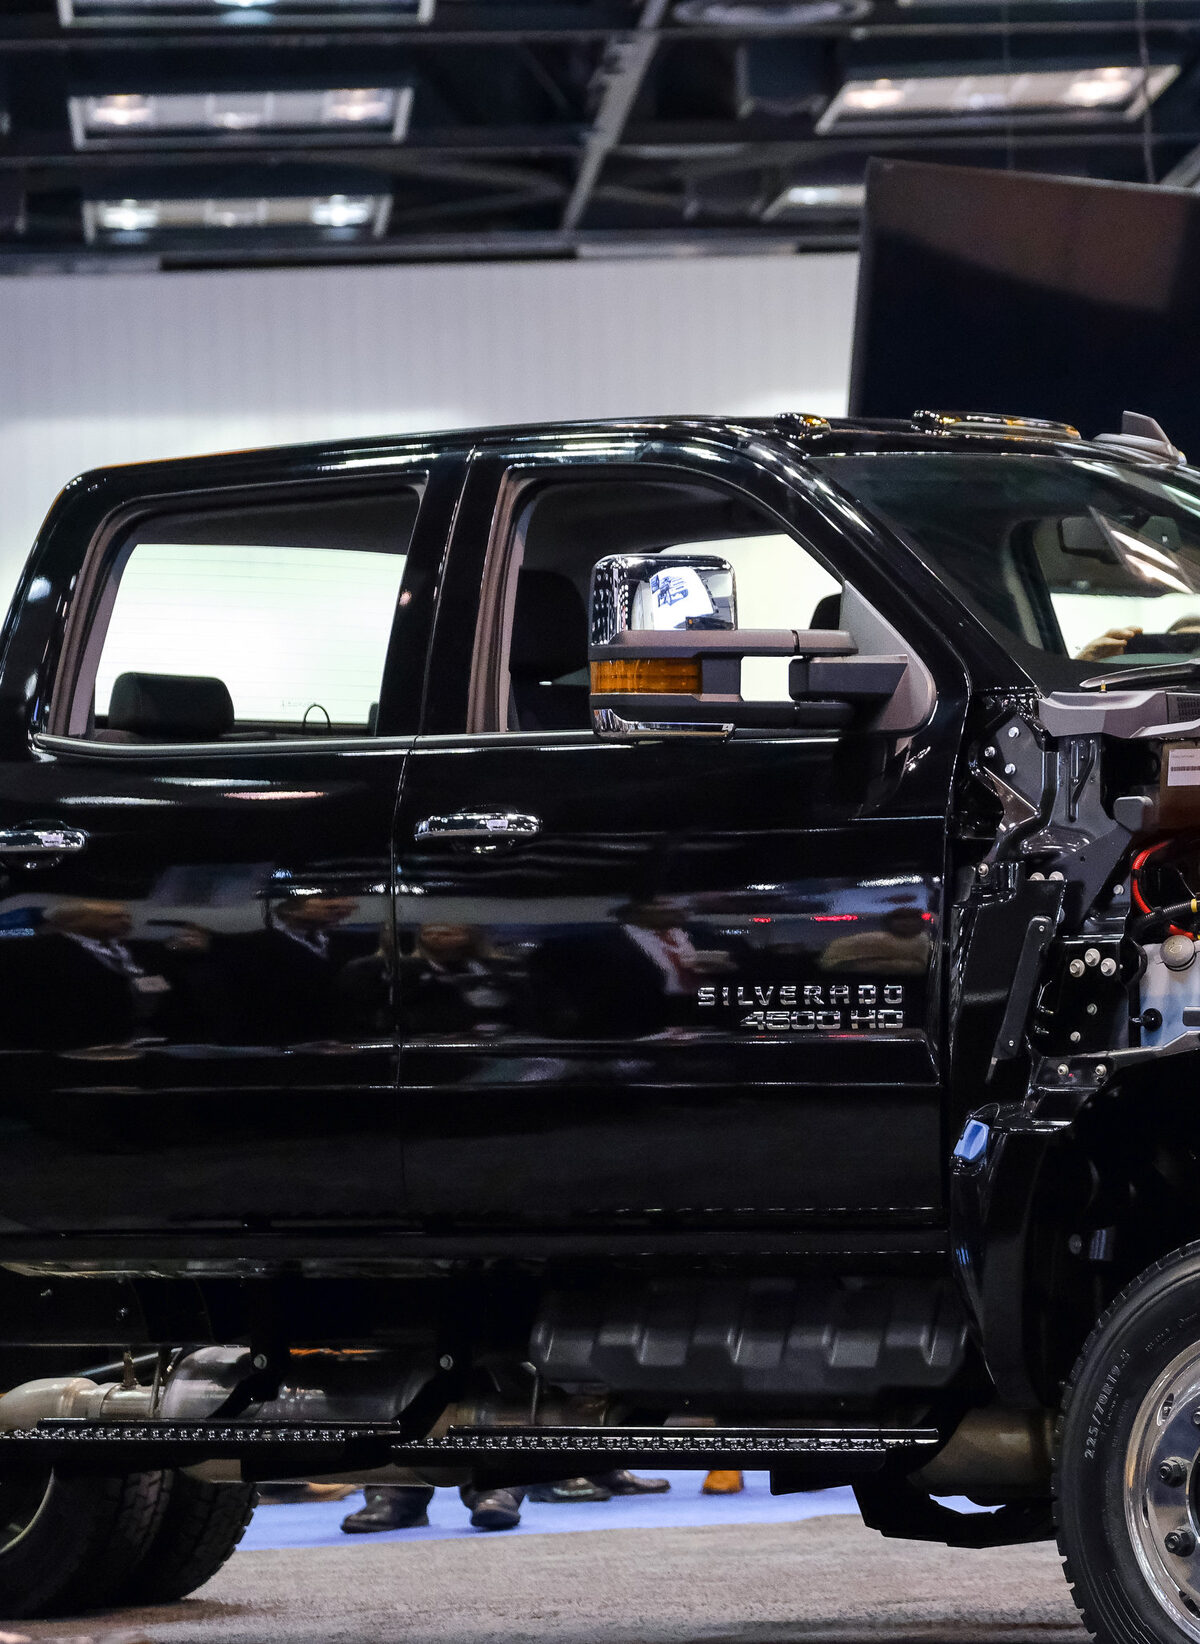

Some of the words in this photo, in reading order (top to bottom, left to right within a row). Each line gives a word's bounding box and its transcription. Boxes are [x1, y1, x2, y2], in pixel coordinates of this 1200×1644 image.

[697, 984, 904, 1006] SILVERADO
[739, 1010, 841, 1030] 4500
[850, 1009, 904, 1030] HD
